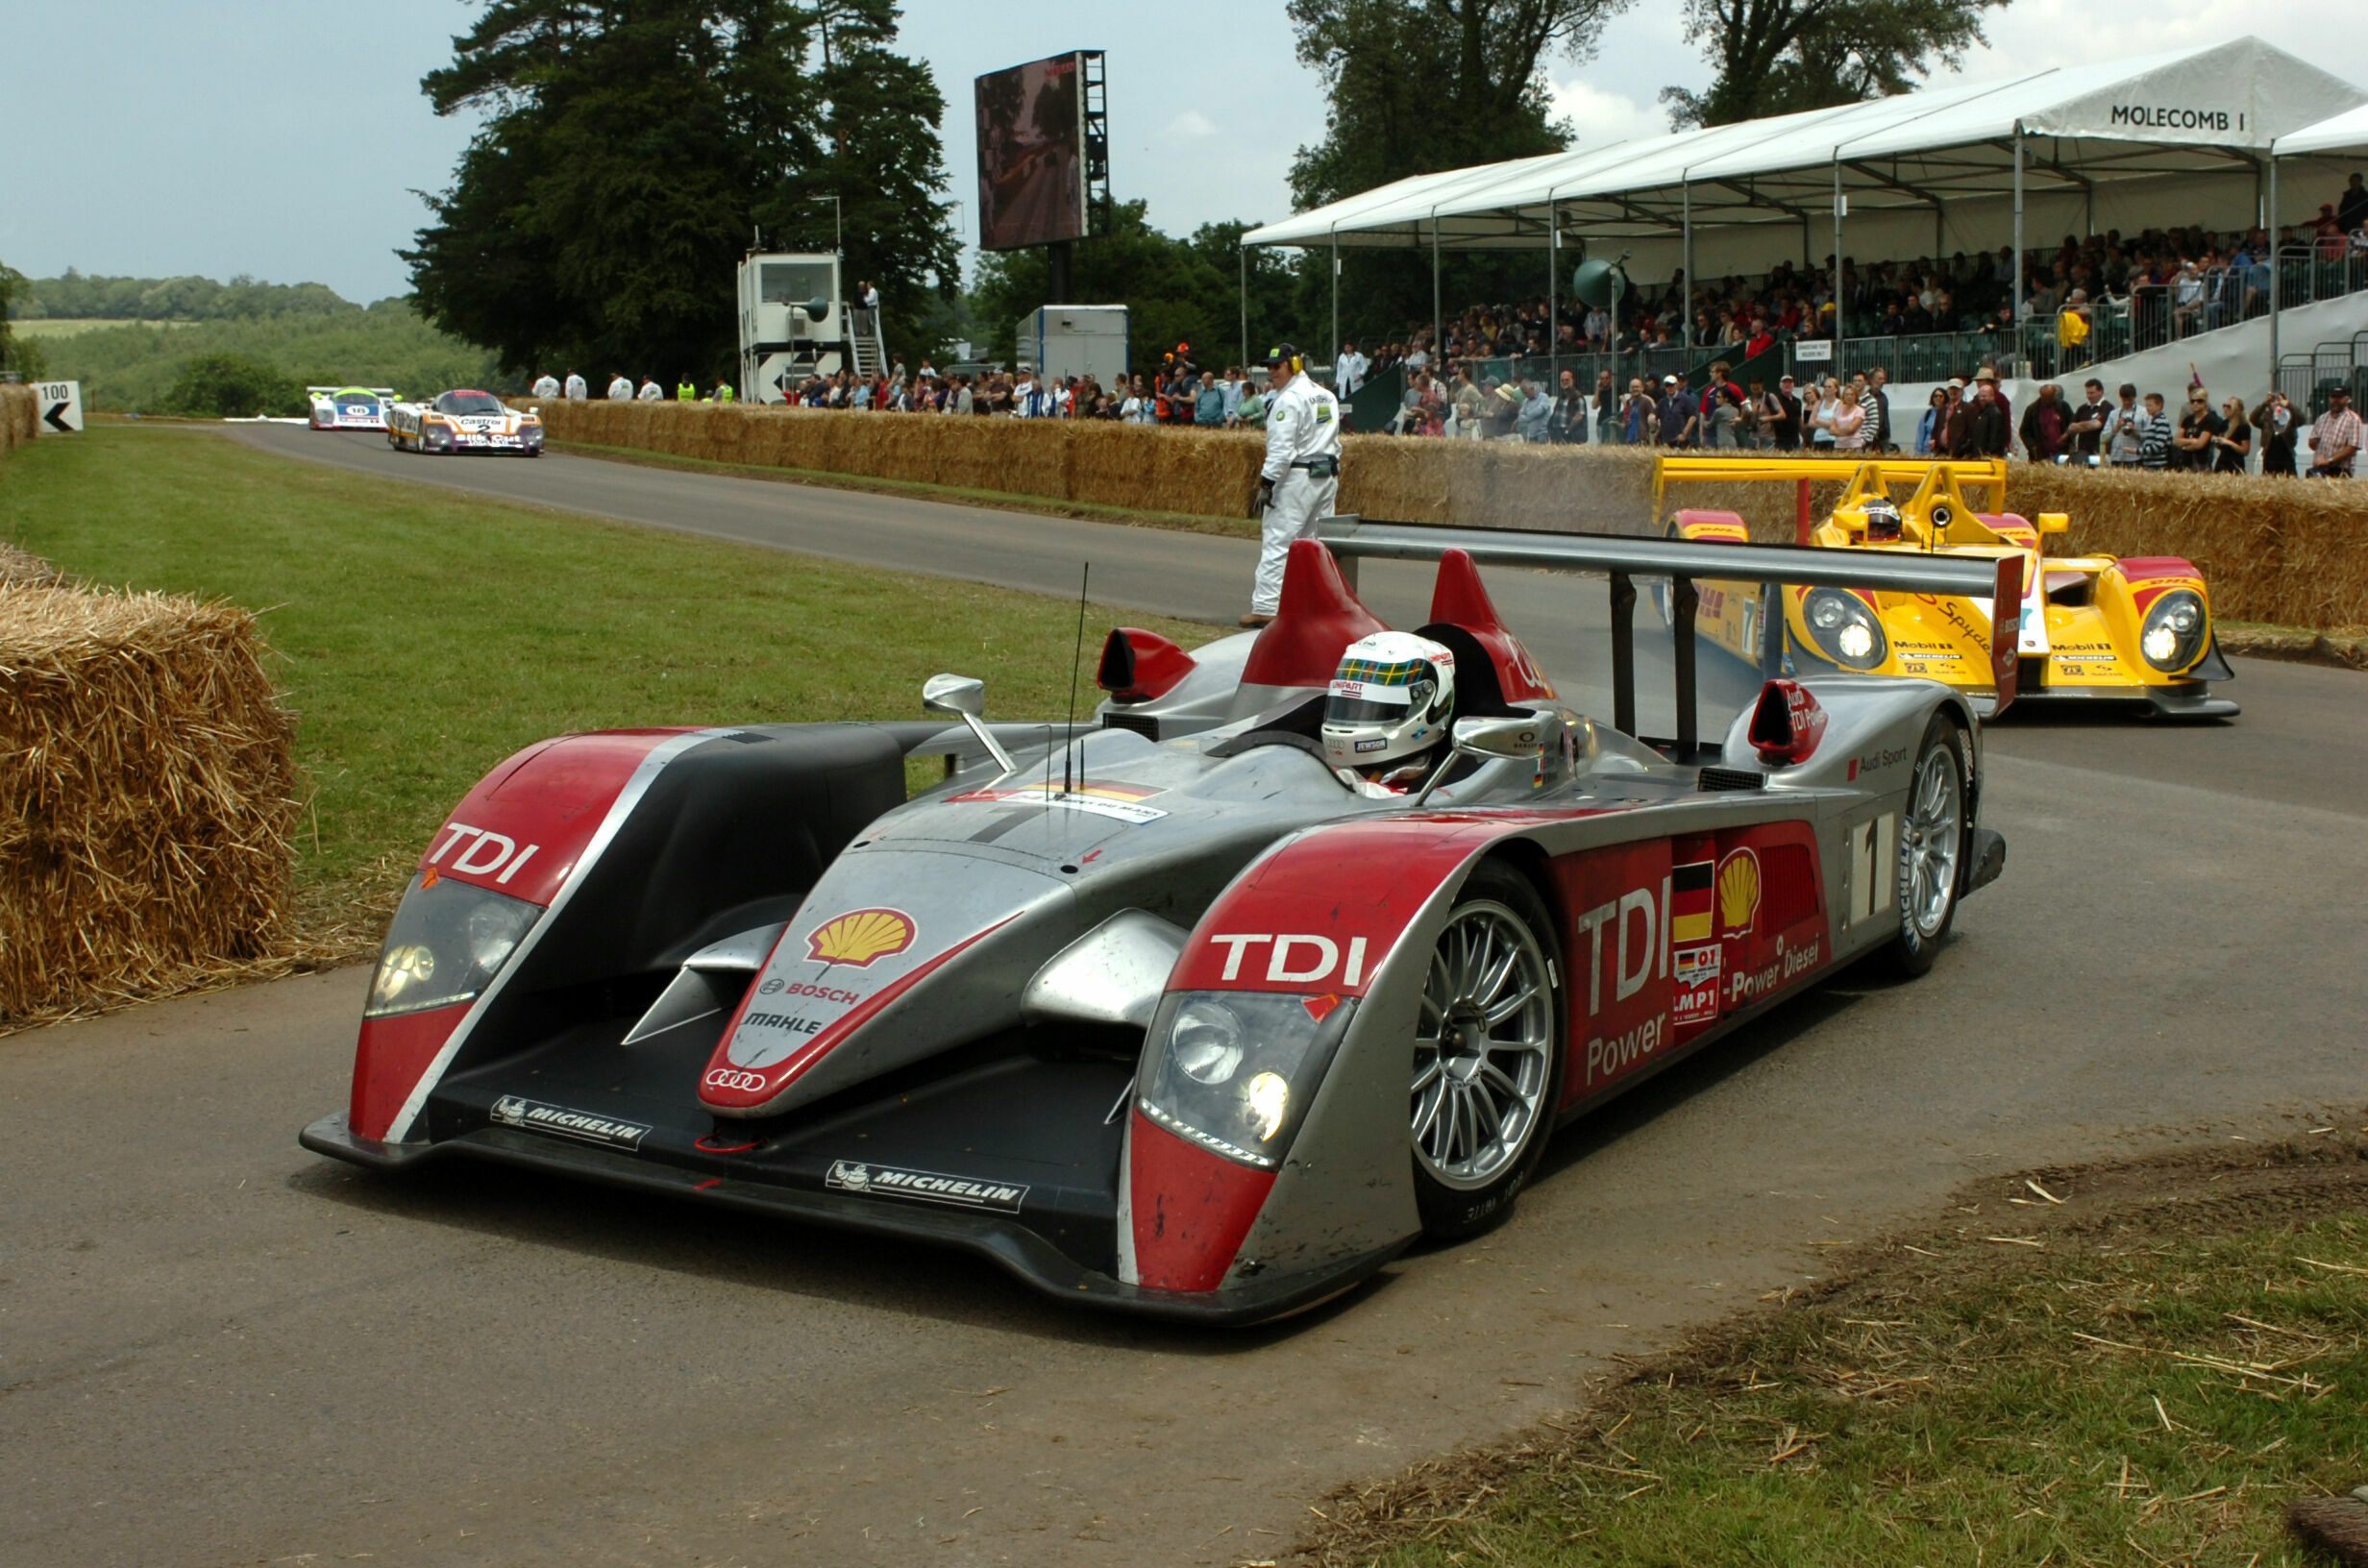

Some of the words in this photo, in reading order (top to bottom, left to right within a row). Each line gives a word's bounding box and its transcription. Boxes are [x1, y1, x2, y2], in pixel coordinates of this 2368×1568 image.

[2110, 105, 2229, 131] MOLECOMB
[42, 384, 68, 401] 100
[460, 417, 502, 426] Castrol
[477, 424, 491, 433] 2
[1744, 600, 1755, 653] 7
[1937, 601, 1991, 655] Spyde
[1893, 641, 1936, 649] Mobil
[1332, 681, 1364, 693] UNIPART
[1787, 683, 1806, 710] Audi
[1790, 709, 1806, 732] TDI
[1860, 750, 1881, 774] Audi
[1882, 746, 1908, 768] Sport
[429, 821, 540, 884] TDI
[1865, 818, 1878, 918] 1
[1578, 875, 1671, 1017] TDI
[1785, 933, 1819, 979] Diesel
[1210, 934, 1368, 987] TDI
[786, 982, 861, 1005] BOSCH
[743, 1012, 823, 1035] MAHLE
[1587, 1012, 1666, 1087] Power
[527, 1106, 643, 1139] MICHELIN
[874, 1170, 1020, 1201] MICHELIN
